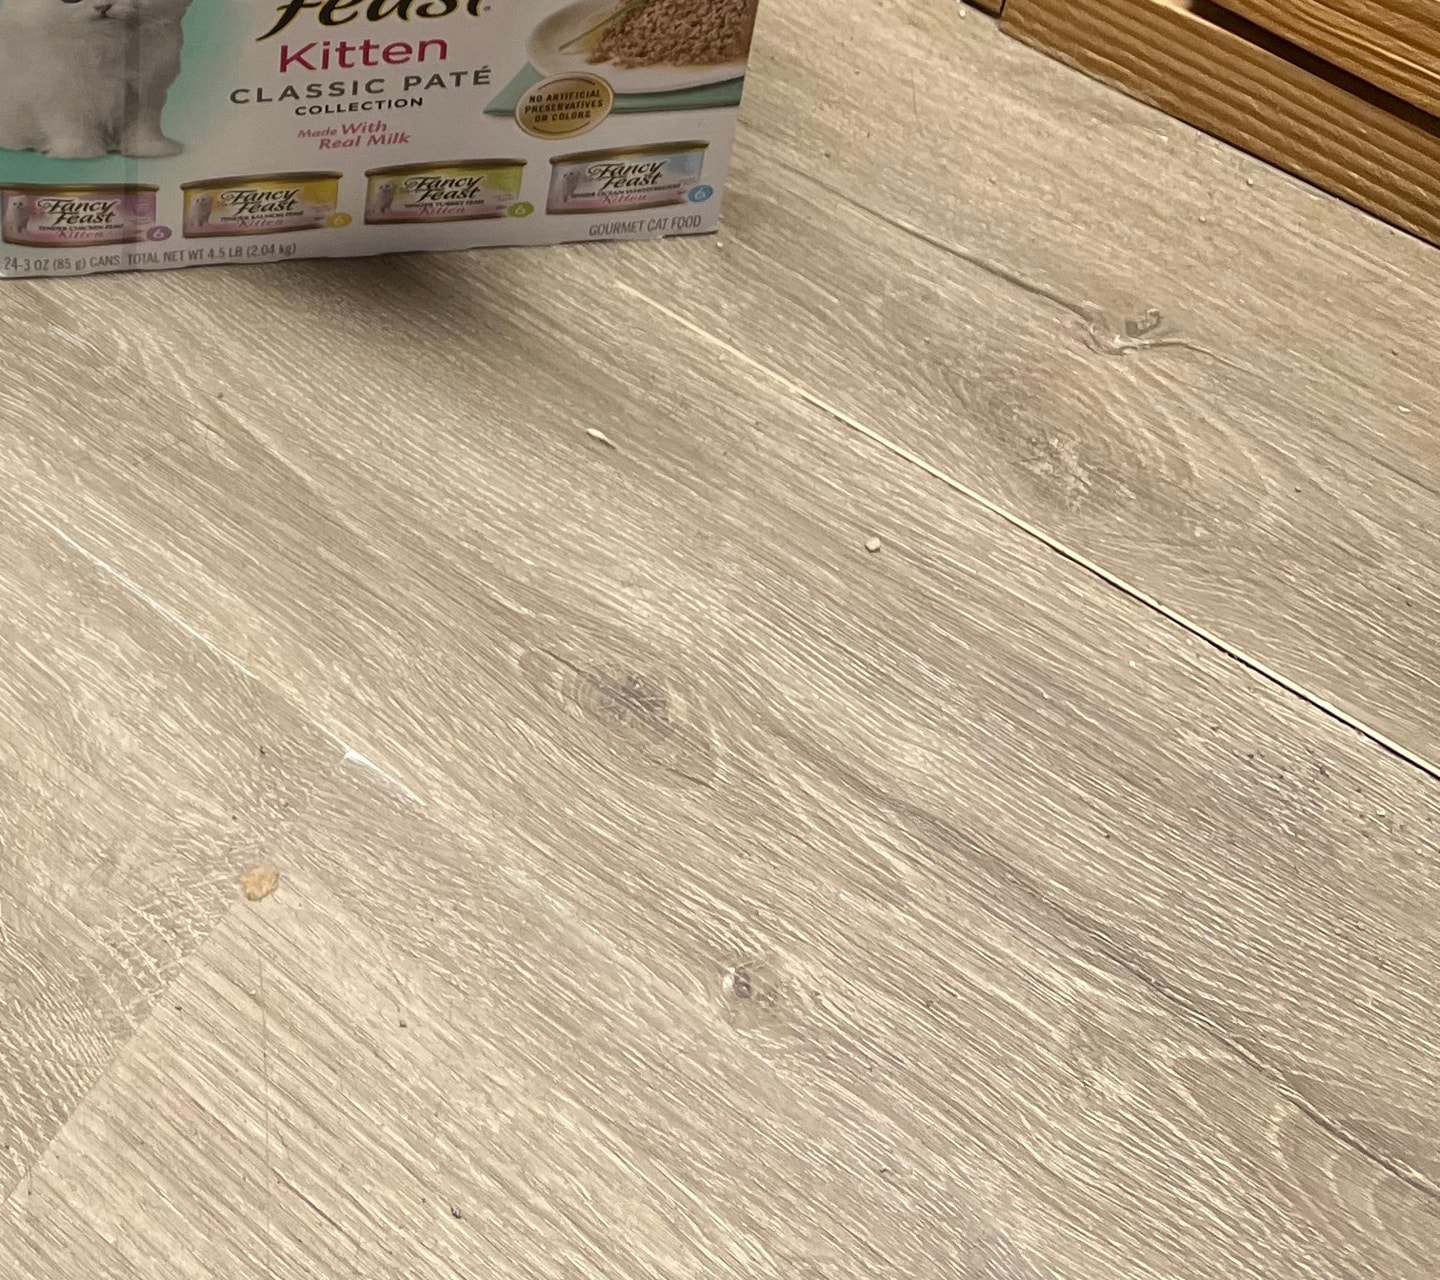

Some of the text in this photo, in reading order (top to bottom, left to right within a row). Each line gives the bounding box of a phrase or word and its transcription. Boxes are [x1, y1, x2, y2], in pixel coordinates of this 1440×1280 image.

[278, 38, 448, 73] Kitten
[229, 65, 492, 106] CLASSIC PATÉ
[295, 96, 424, 116] COLLECTION
[296, 119, 388, 139] Made With
[318, 130, 410, 150] Real Milk
